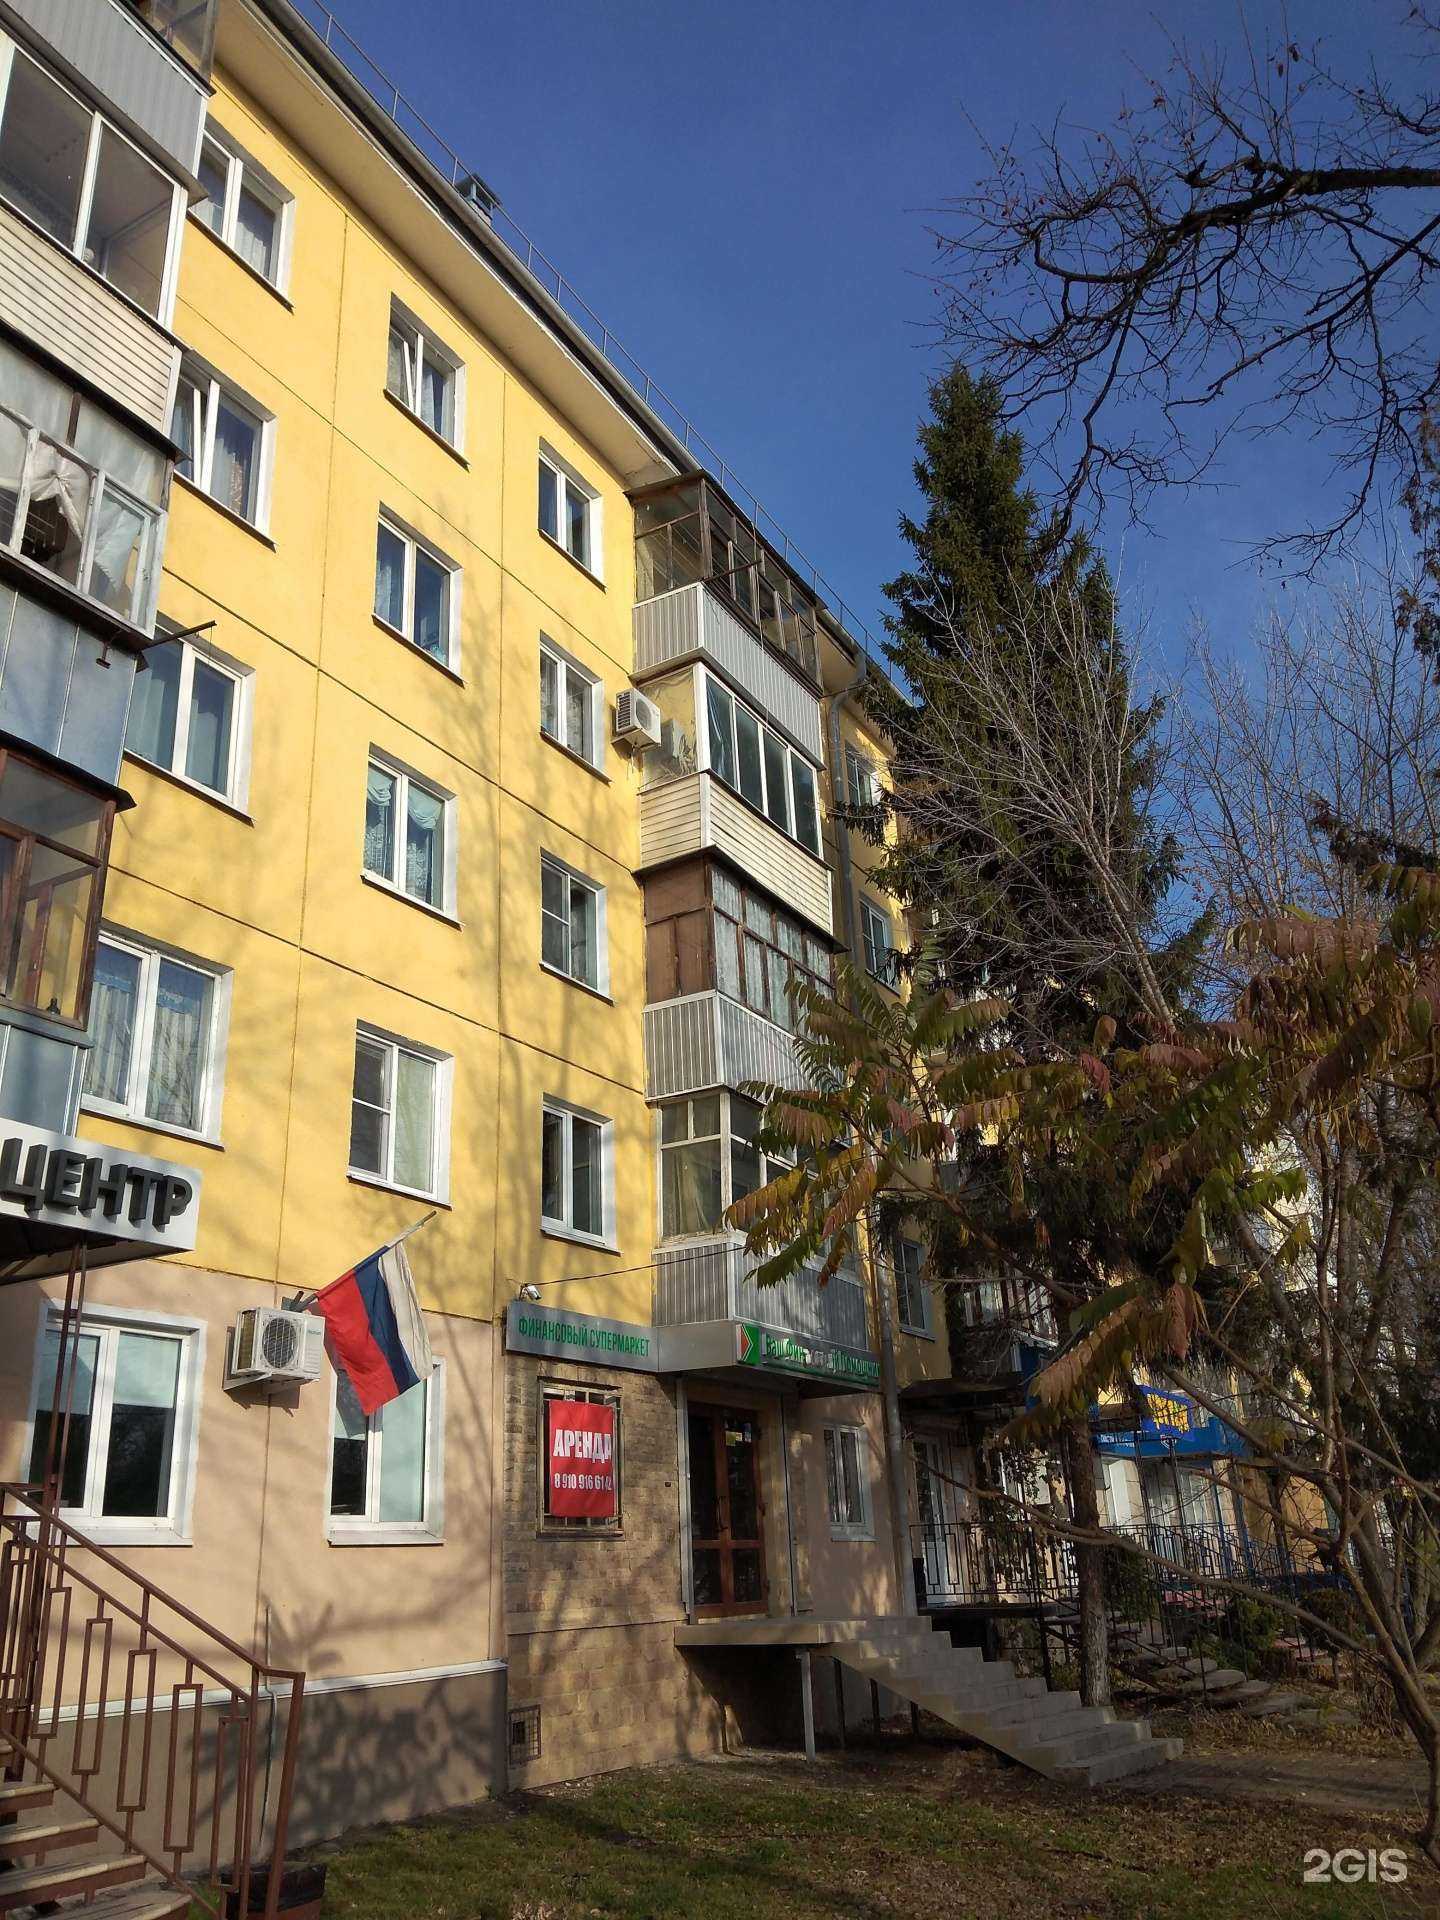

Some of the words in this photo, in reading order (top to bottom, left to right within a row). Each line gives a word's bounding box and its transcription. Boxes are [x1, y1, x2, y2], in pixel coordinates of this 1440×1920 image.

[0, 1137, 193, 1229] ЦЕНТР
[518, 1316, 588, 1346] ФИНАНСОВЫЙ
[590, 1328, 651, 1357] СУПЕРМАРКЕТ
[553, 1429, 612, 1463] АРЕНДА
[554, 1472, 561, 1489] 8
[562, 1473, 577, 1489] 910
[578, 1474, 593, 1490] 916
